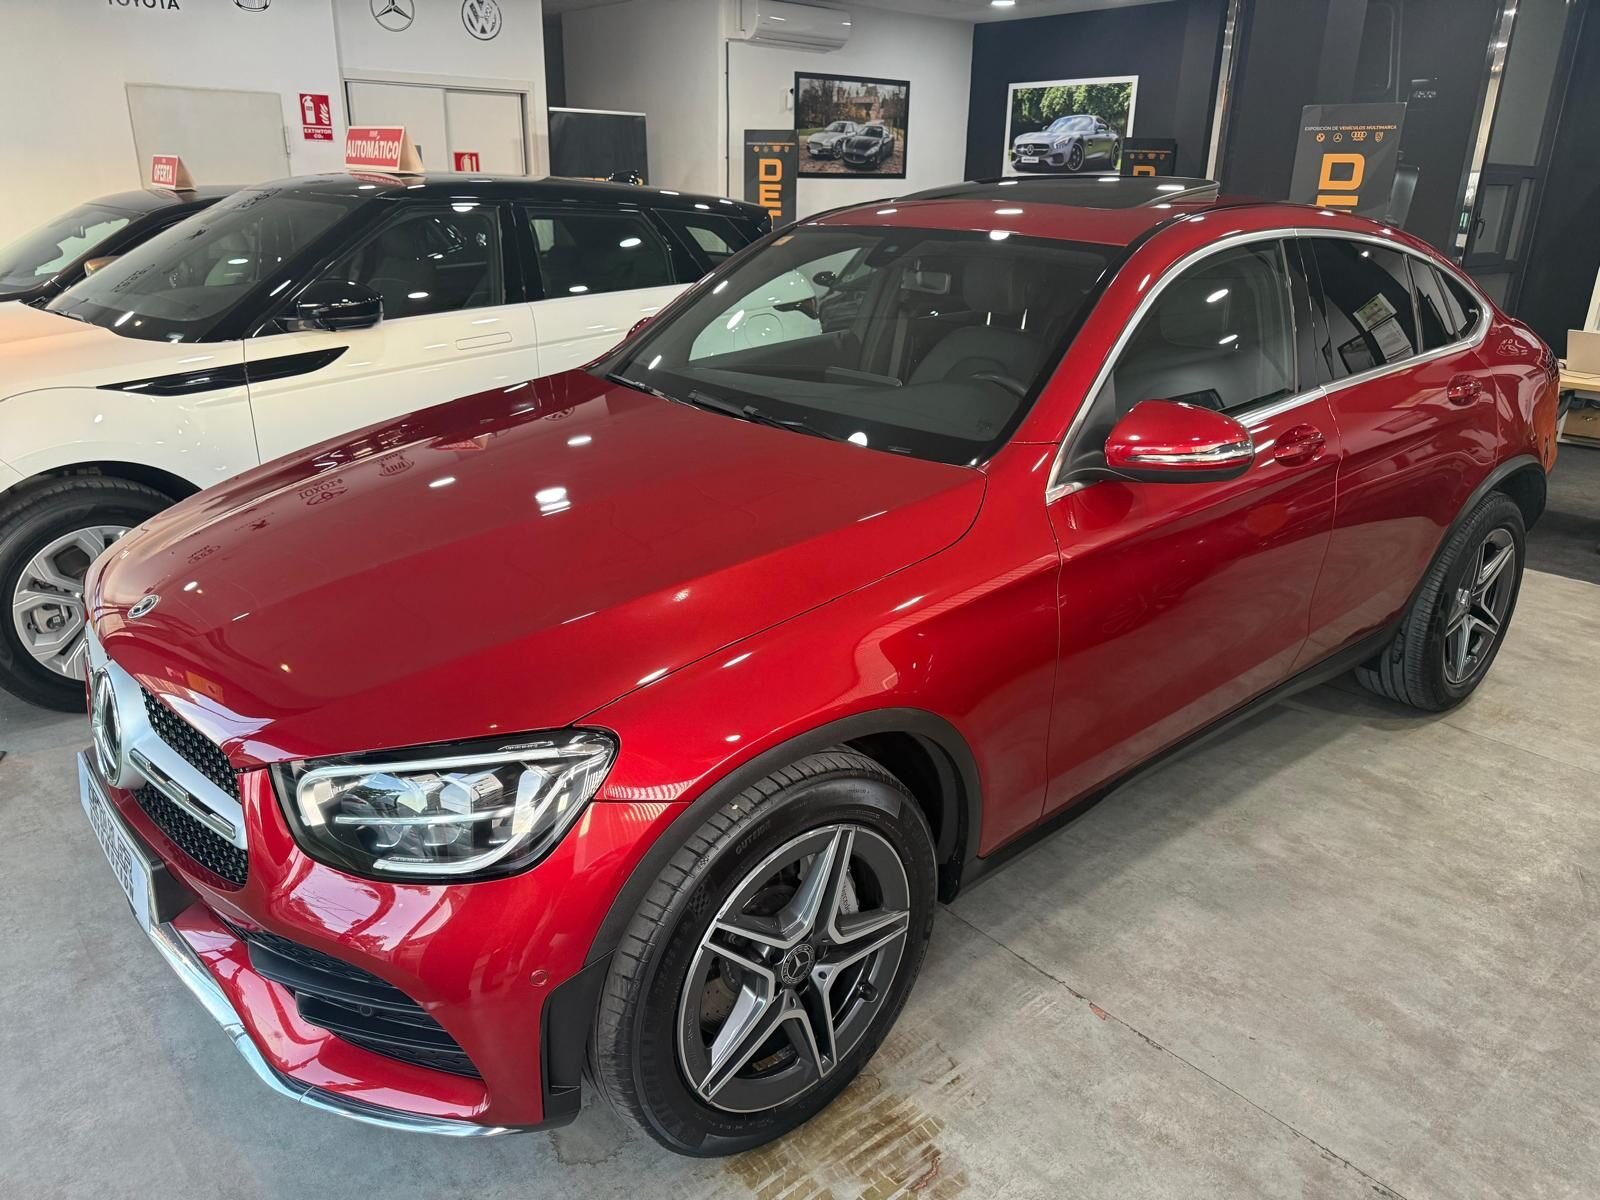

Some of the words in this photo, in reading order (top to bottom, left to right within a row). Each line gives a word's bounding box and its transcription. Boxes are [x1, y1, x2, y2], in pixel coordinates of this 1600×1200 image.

[346, 135, 399, 160] AUTOMÁTICO
[153, 163, 174, 183] OFERTA
[758, 158, 783, 217] DE
[1315, 153, 1366, 207] D
